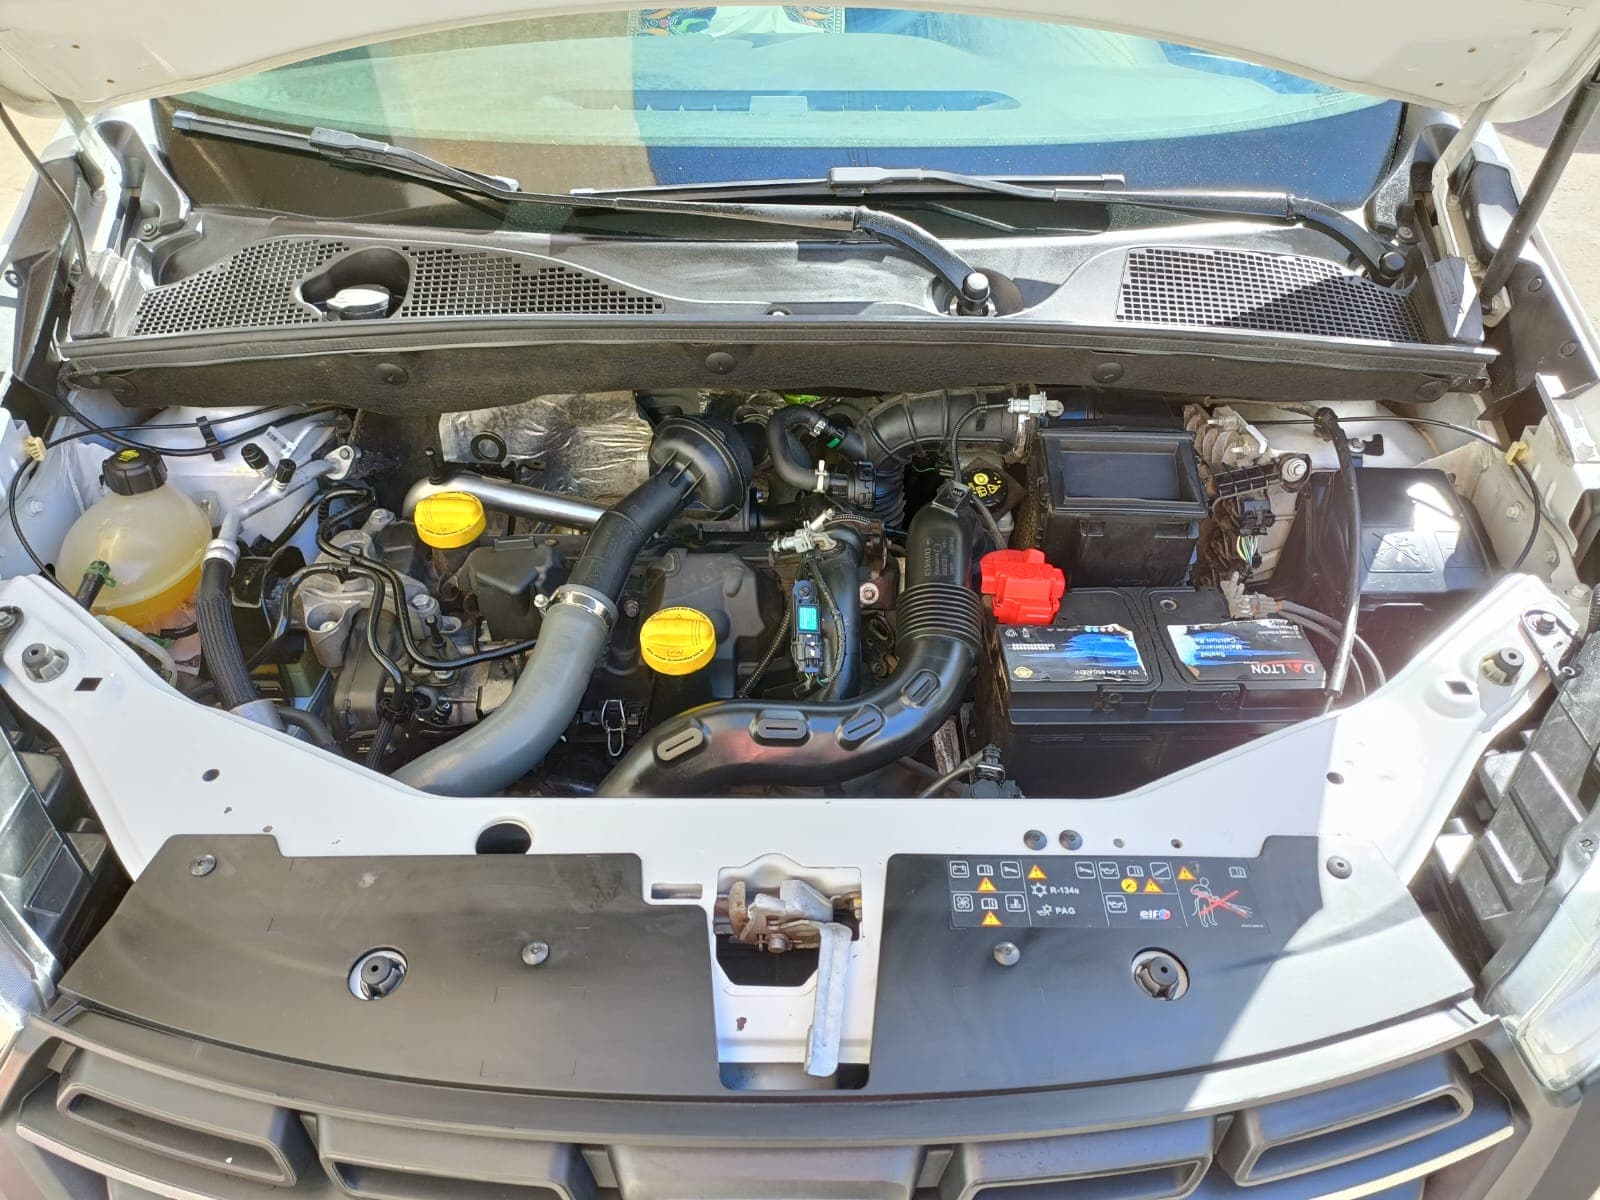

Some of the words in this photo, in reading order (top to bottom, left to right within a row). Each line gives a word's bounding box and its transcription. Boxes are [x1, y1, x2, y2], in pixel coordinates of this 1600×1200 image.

[1251, 664, 1315, 674] DALTON
[1050, 886, 1079, 895] R-134a
[1055, 907, 1076, 915] PAG
[1140, 910, 1159, 920] elf
